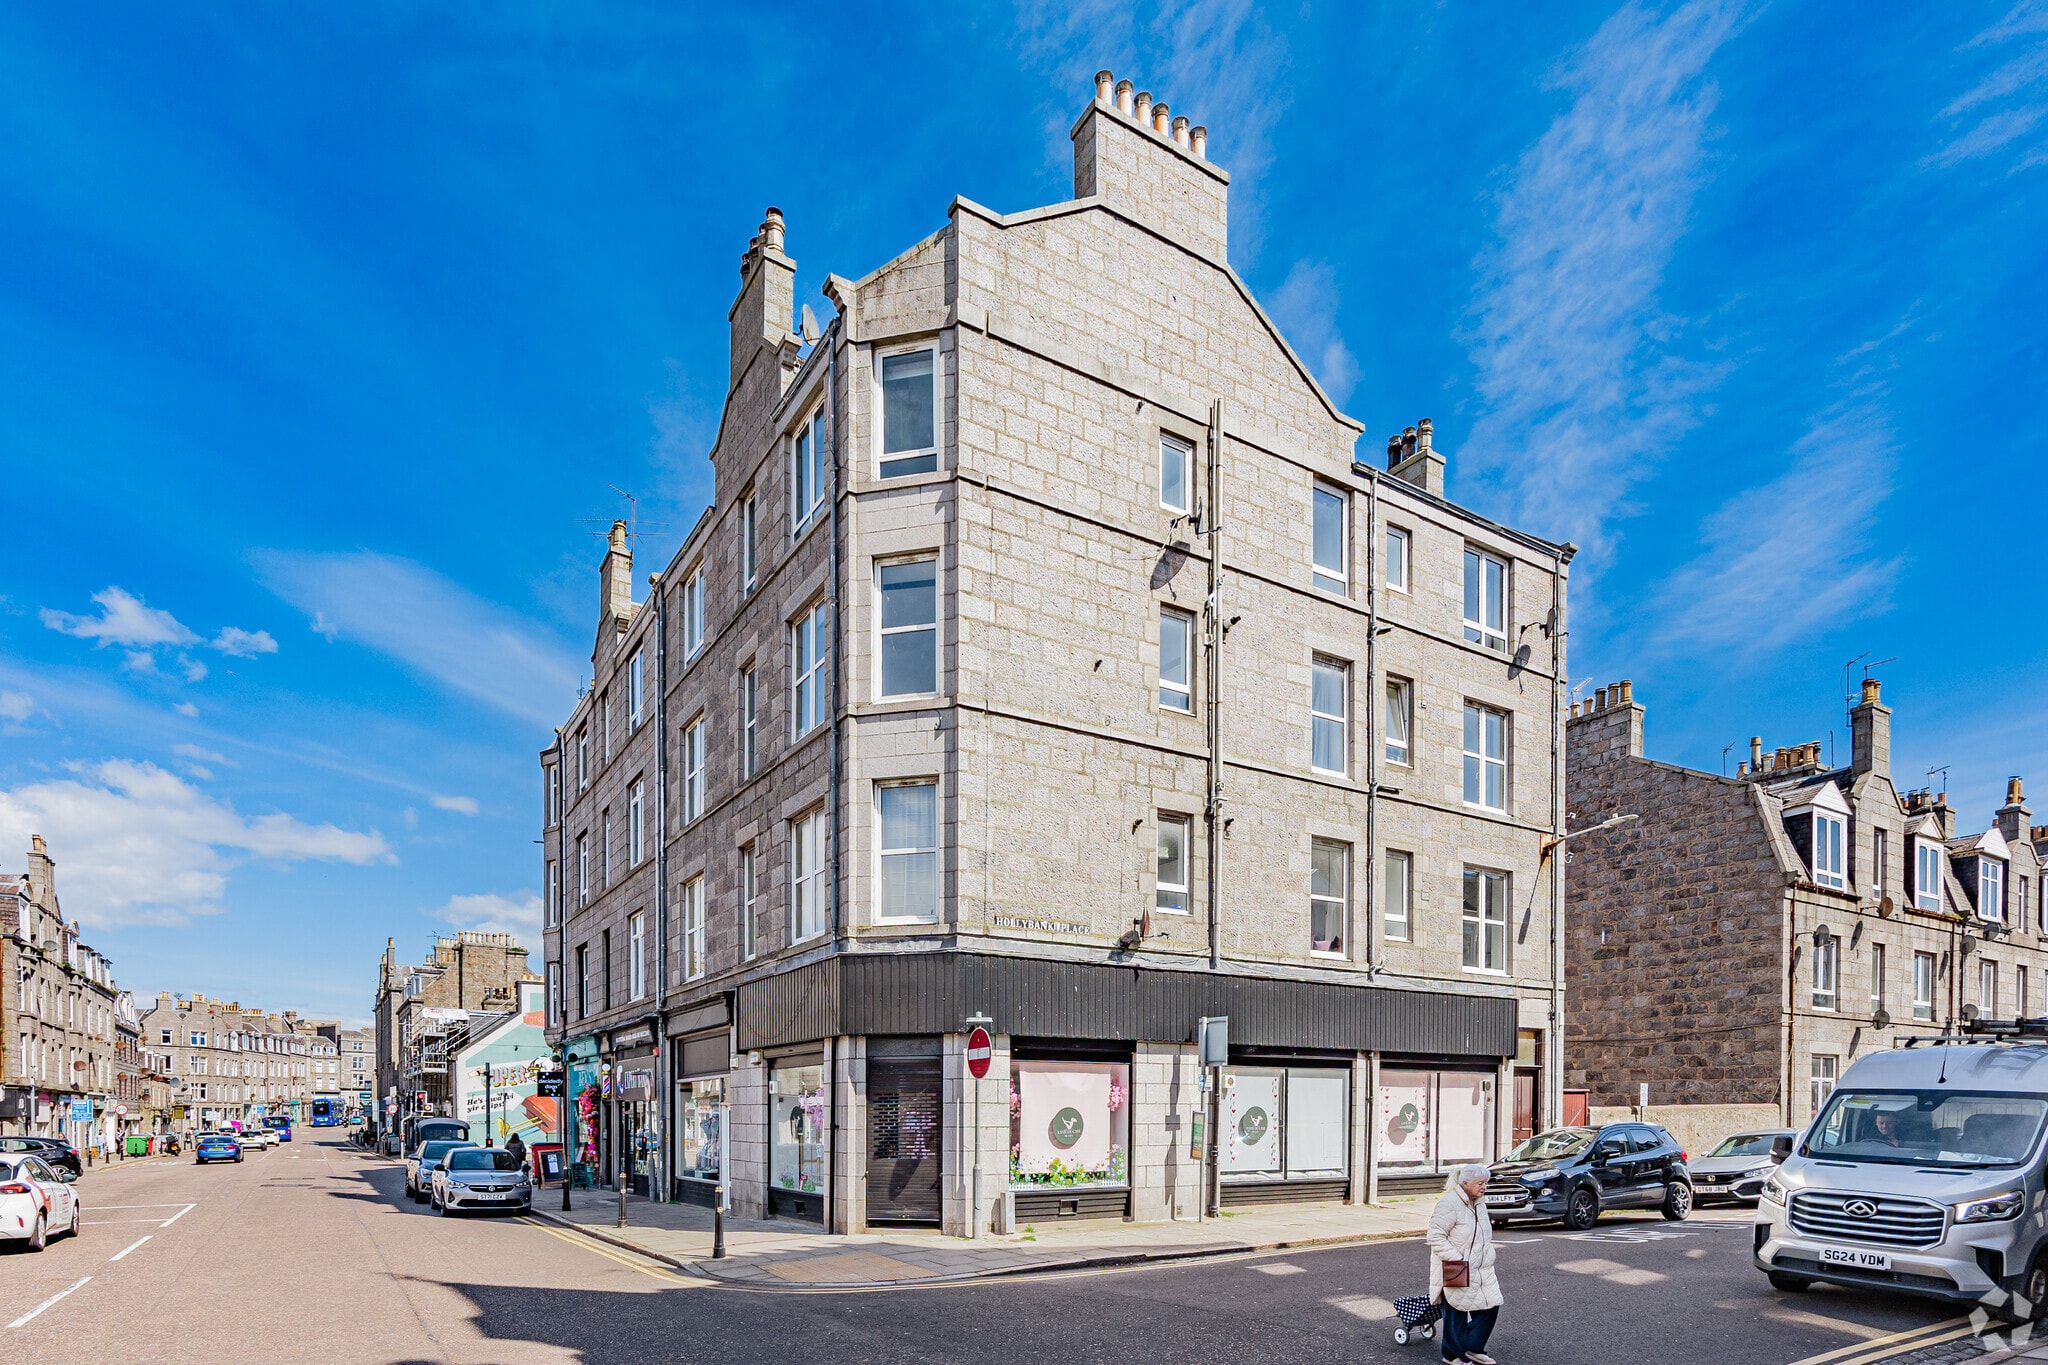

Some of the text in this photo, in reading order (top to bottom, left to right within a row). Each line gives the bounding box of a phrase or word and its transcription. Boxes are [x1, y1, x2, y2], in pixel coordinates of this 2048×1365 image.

[996, 916, 1090, 934] HOLLYBANK PLACE
[467, 1097, 483, 1106] He's
[467, 1101, 505, 1114] yir cips!
[1824, 1249, 1885, 1267] SG24 VDM
